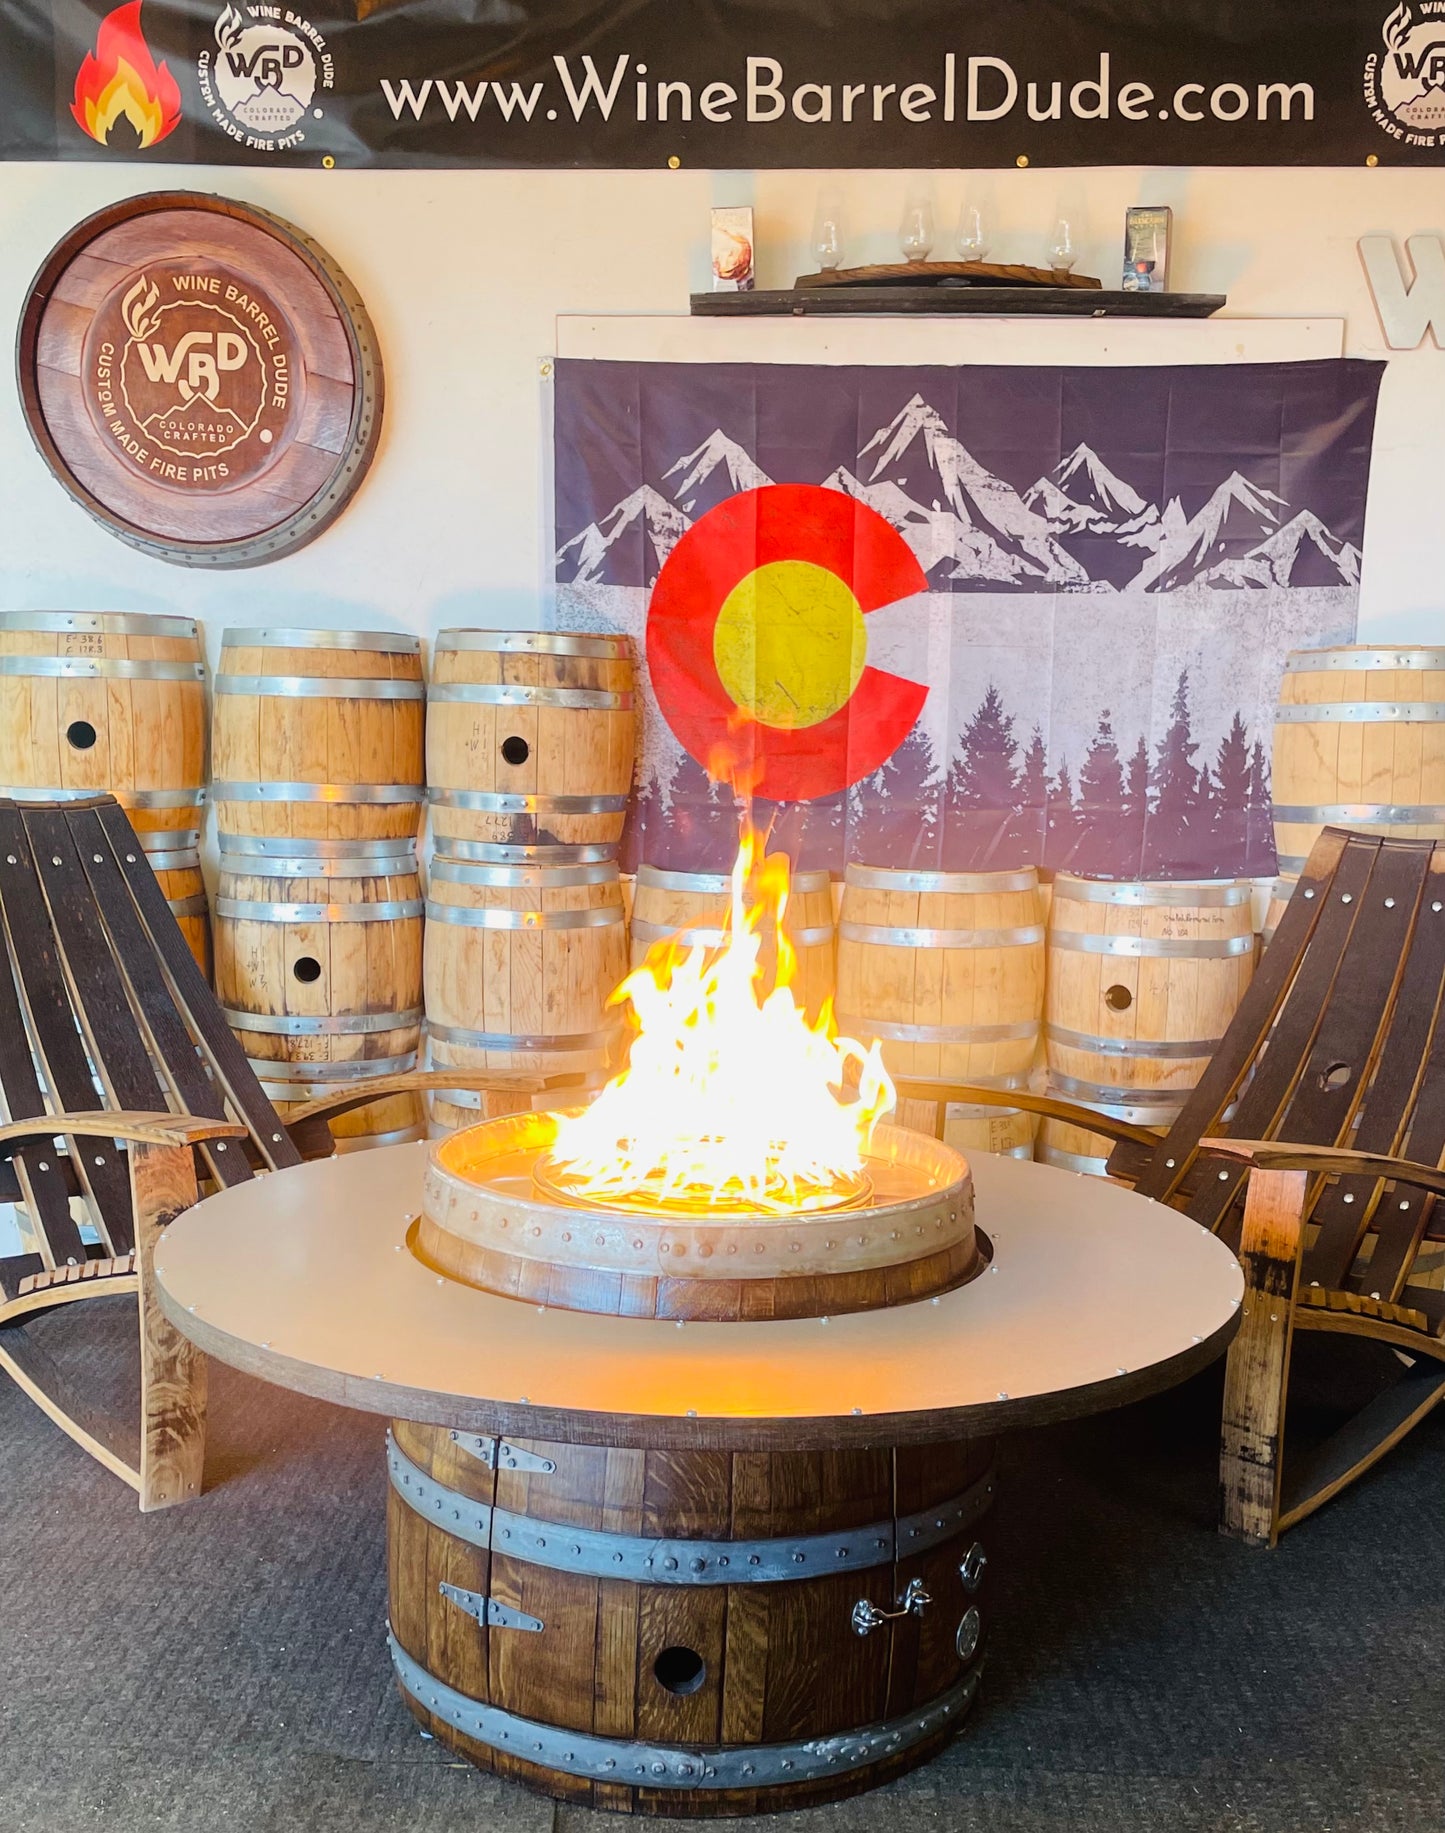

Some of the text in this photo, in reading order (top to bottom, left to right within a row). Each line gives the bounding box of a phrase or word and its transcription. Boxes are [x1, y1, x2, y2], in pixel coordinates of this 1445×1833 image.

[246, 5, 334, 89] WINE BARREL DUDE
[379, 52, 1315, 122] www.WineBarrelDude.com
[198, 50, 305, 151] CUSTOM MADE FIRE PITS
[1363, 53, 1435, 147] CUSTOM MADE FIRE
[172, 275, 288, 410] WINE BARREL DUDE
[97, 342, 230, 482] CUSTOM MADE FIRE PITS
[159, 420, 234, 434] COLORADO
[163, 430, 226, 443] CRAFTED
